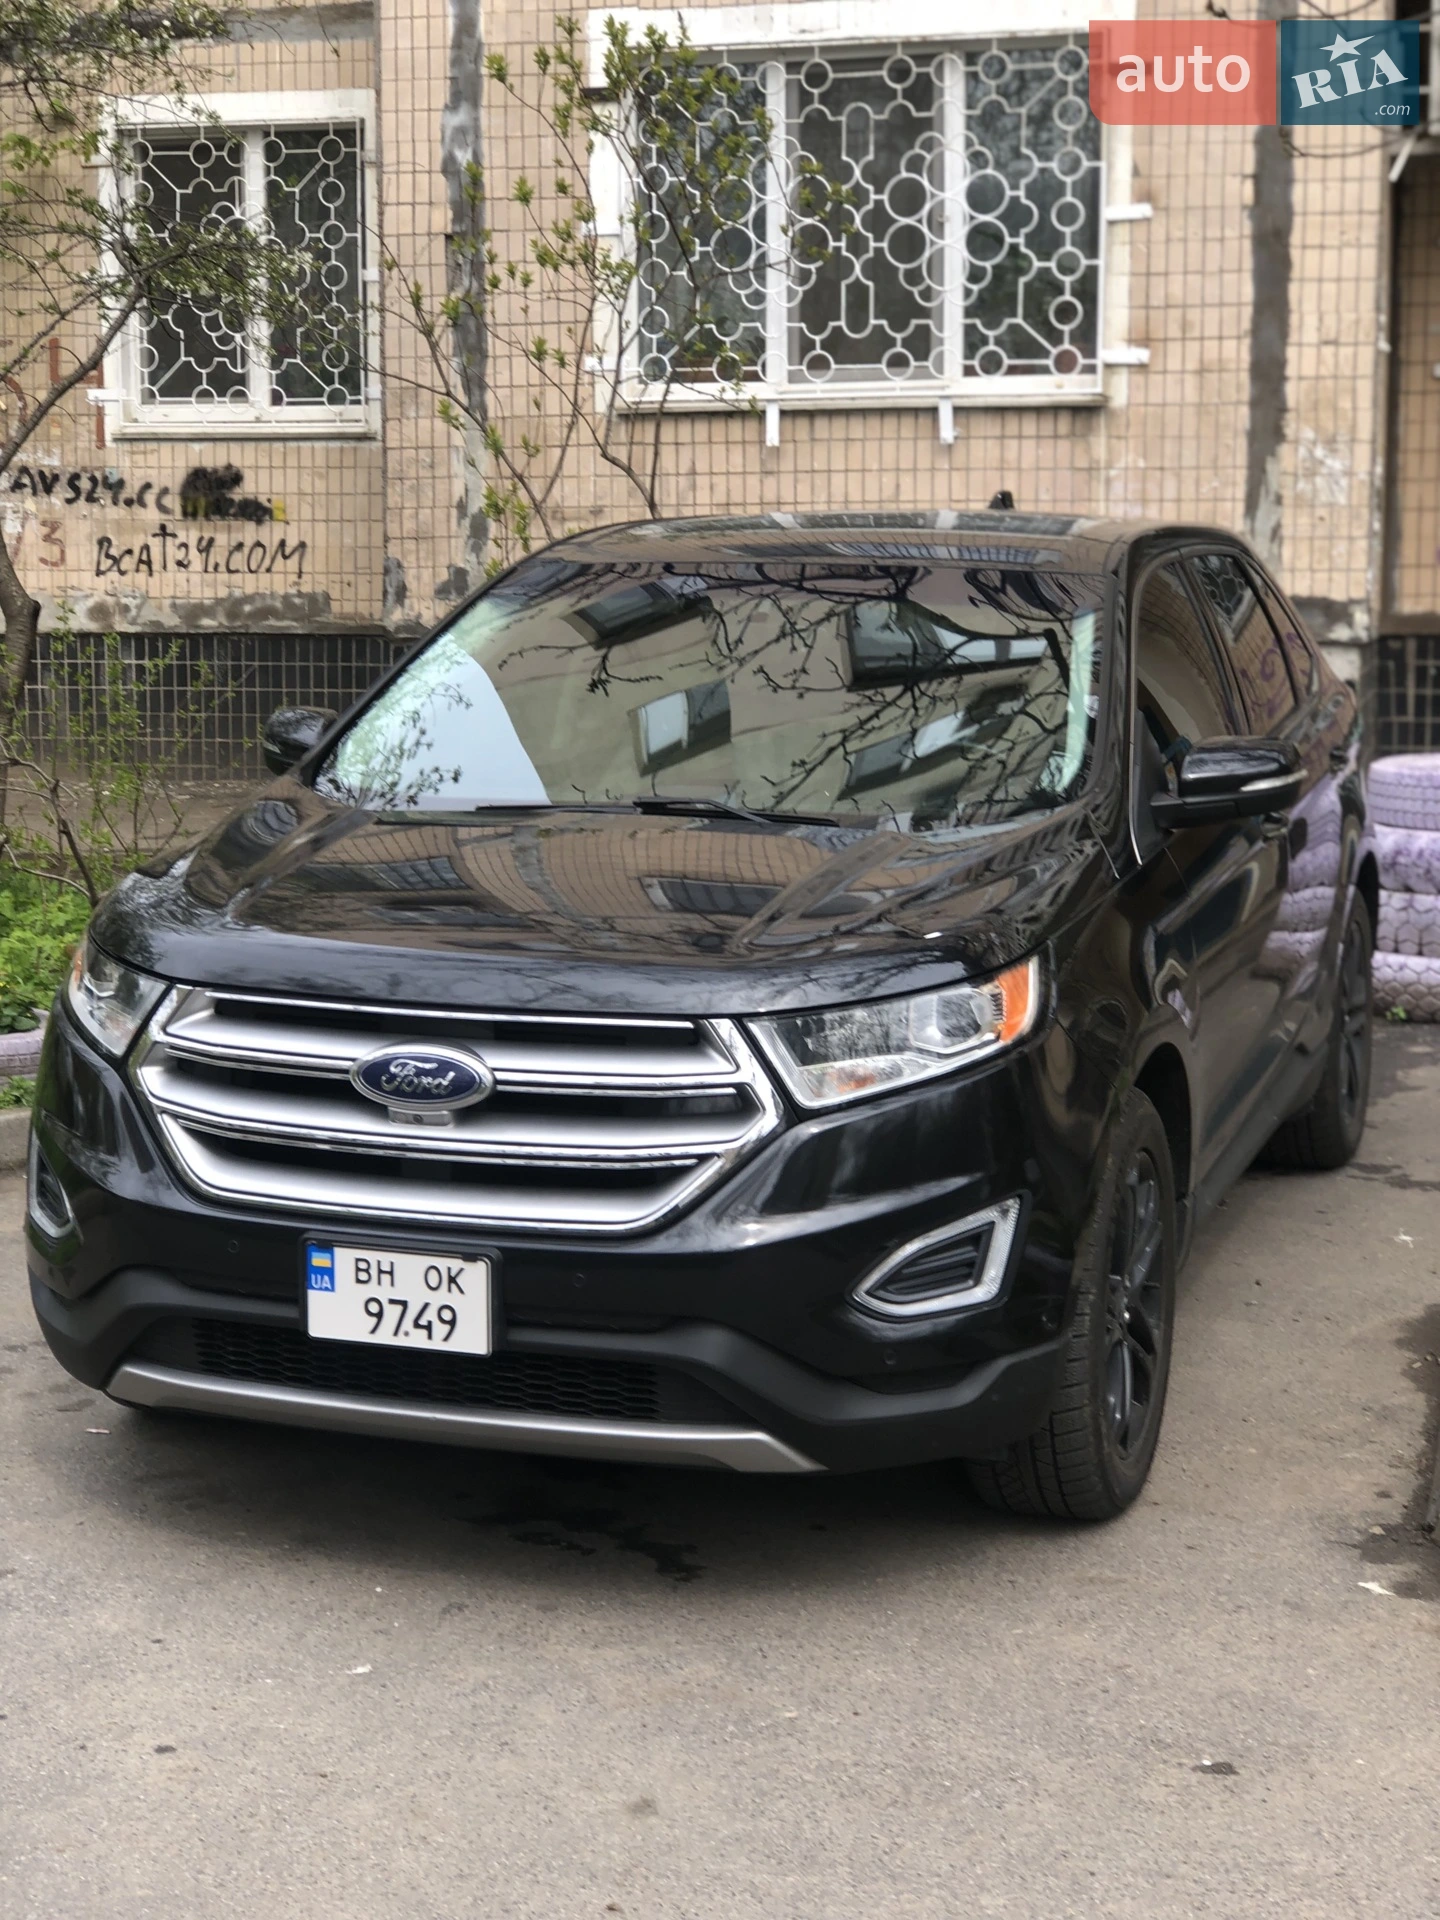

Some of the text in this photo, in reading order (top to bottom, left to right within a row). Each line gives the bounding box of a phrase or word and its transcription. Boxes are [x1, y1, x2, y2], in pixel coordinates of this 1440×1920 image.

[380, 1058, 456, 1095] Ford
[311, 1273, 332, 1290] UA
[354, 1257, 465, 1295] BH OK
